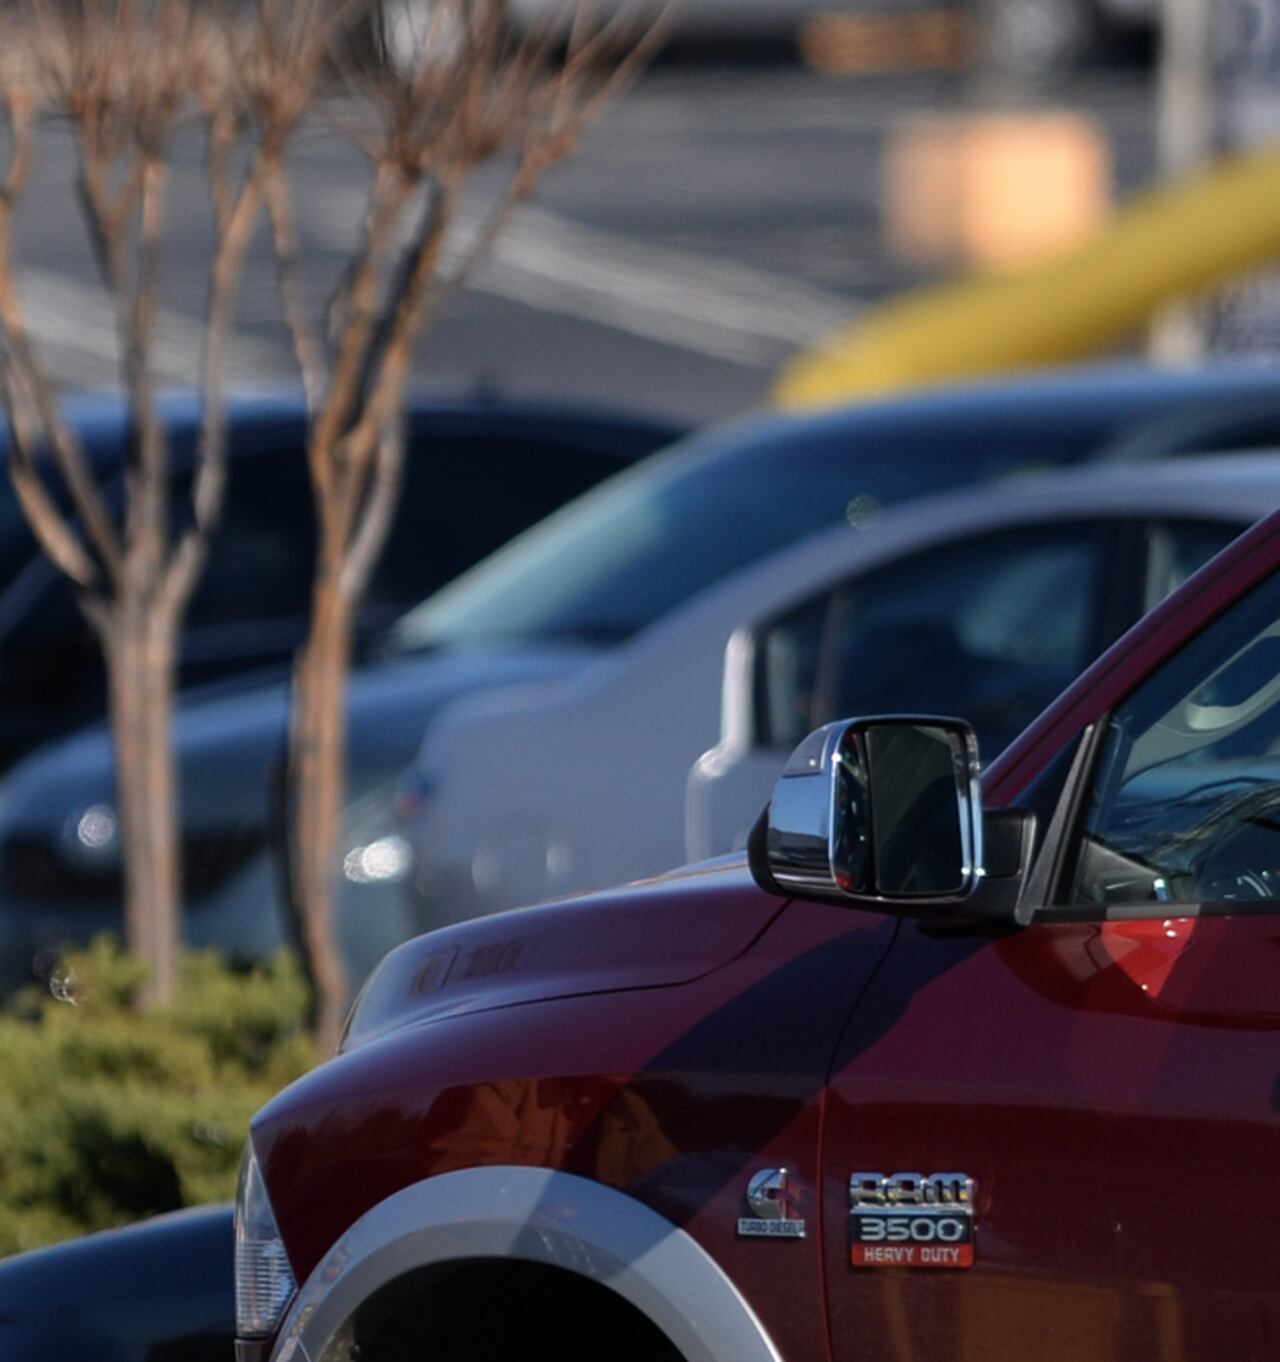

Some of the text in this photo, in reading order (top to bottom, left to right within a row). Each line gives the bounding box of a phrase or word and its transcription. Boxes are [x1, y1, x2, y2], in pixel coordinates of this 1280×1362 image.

[860, 1218, 964, 1241] 3500
[864, 1246, 961, 1262] HEAVY DUTY
